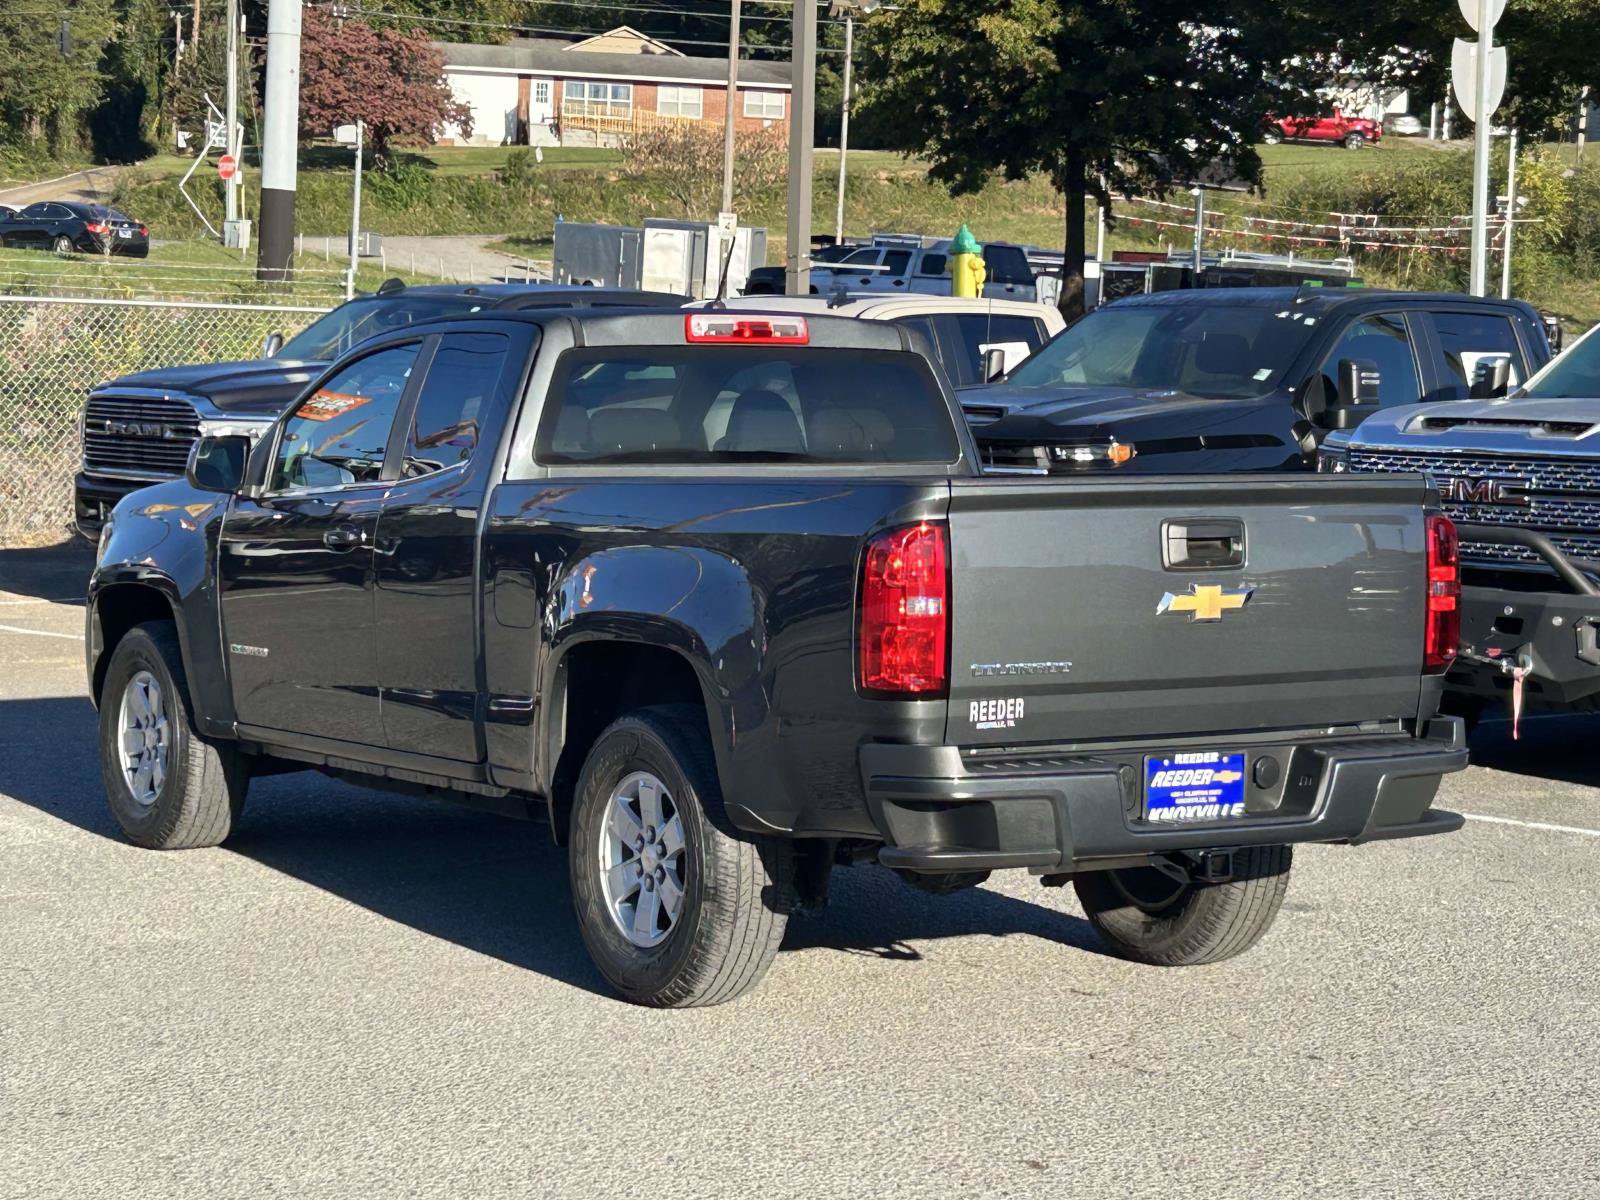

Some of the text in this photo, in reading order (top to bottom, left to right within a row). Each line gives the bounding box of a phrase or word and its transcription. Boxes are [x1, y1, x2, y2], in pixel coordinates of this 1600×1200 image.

[969, 697, 1025, 722] REEDER
[1174, 751, 1220, 764] REEDER
[1150, 768, 1215, 788] REEDER
